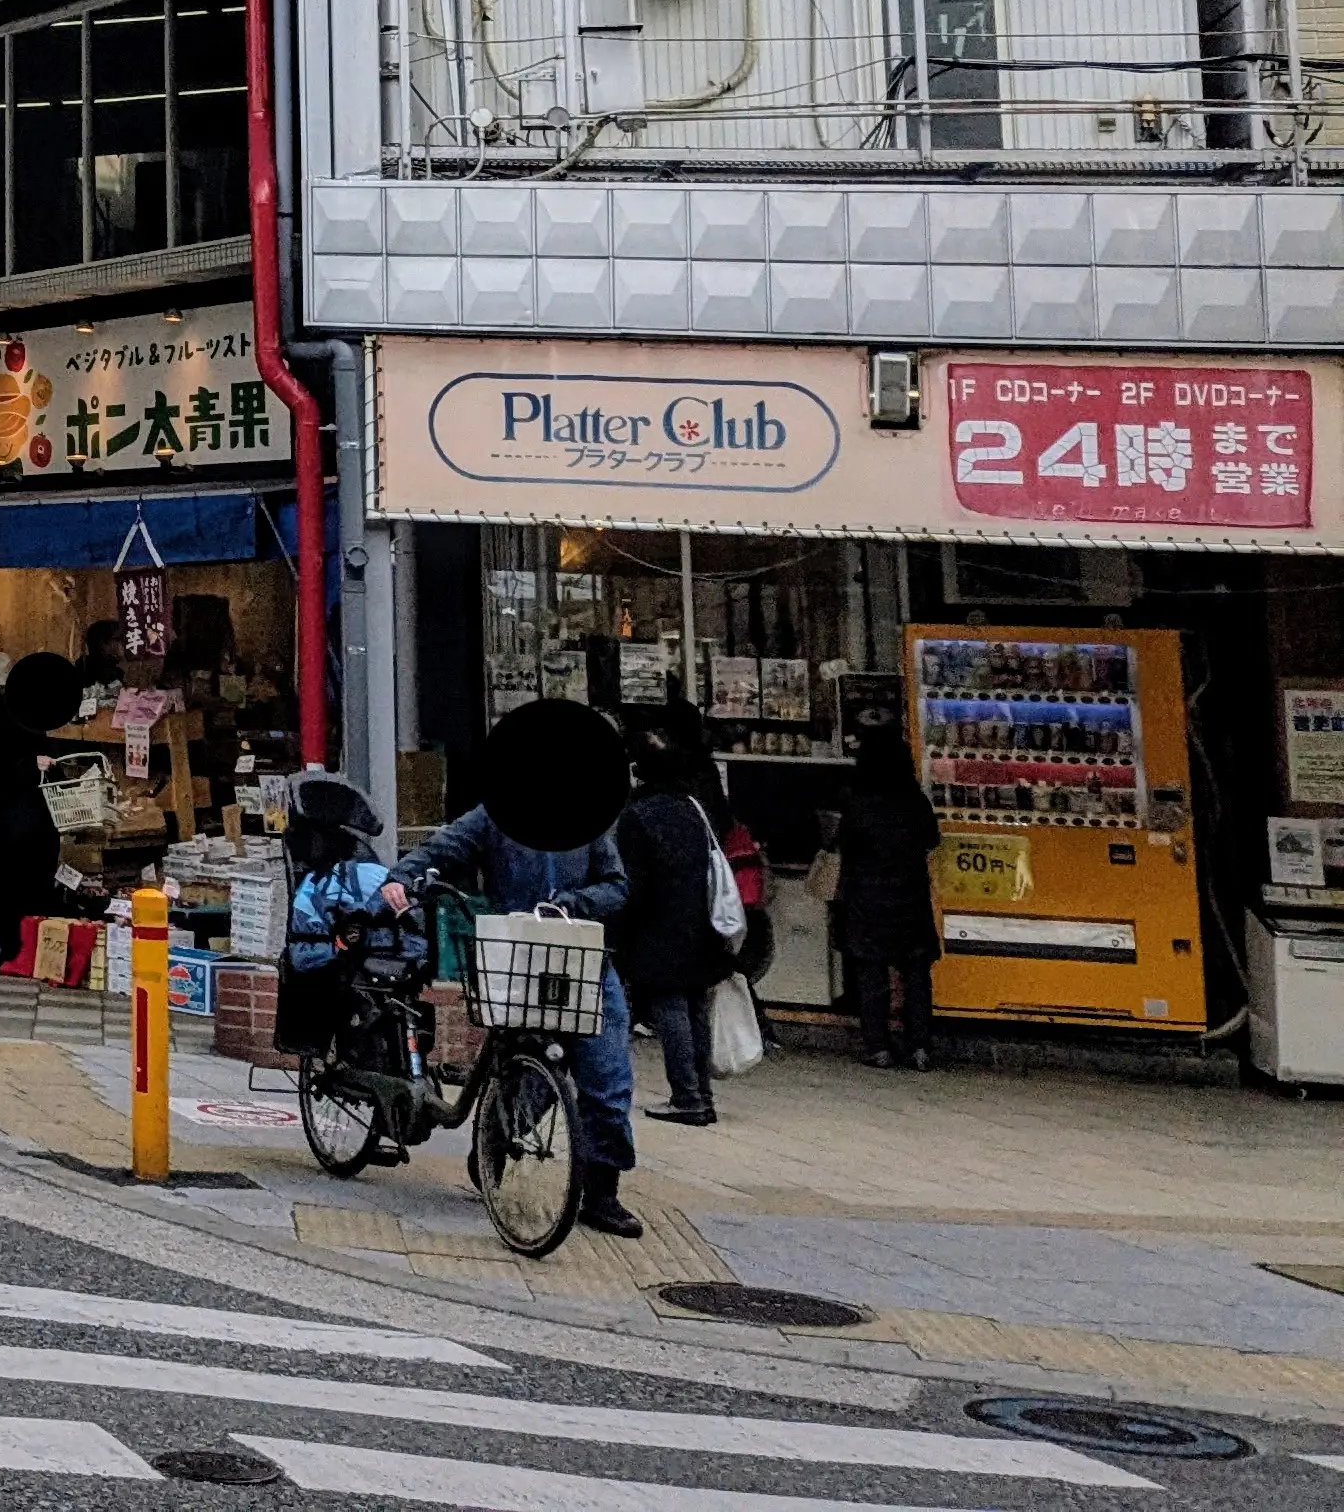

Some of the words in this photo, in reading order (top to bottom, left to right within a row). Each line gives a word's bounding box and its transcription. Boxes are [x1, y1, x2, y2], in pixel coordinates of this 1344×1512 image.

[949, 379, 976, 400] 1F
[996, 379, 1102, 404] CDコーナー
[1120, 381, 1156, 406] 2F
[1174, 382, 1300, 408] DVDコーナー
[66, 380, 271, 459] ポン太青果
[501, 390, 652, 445] Platter
[662, 395, 788, 451] Club
[1211, 422, 1298, 456] まで
[563, 445, 712, 474] プラタークラブ
[1211, 460, 1300, 497] 営業
